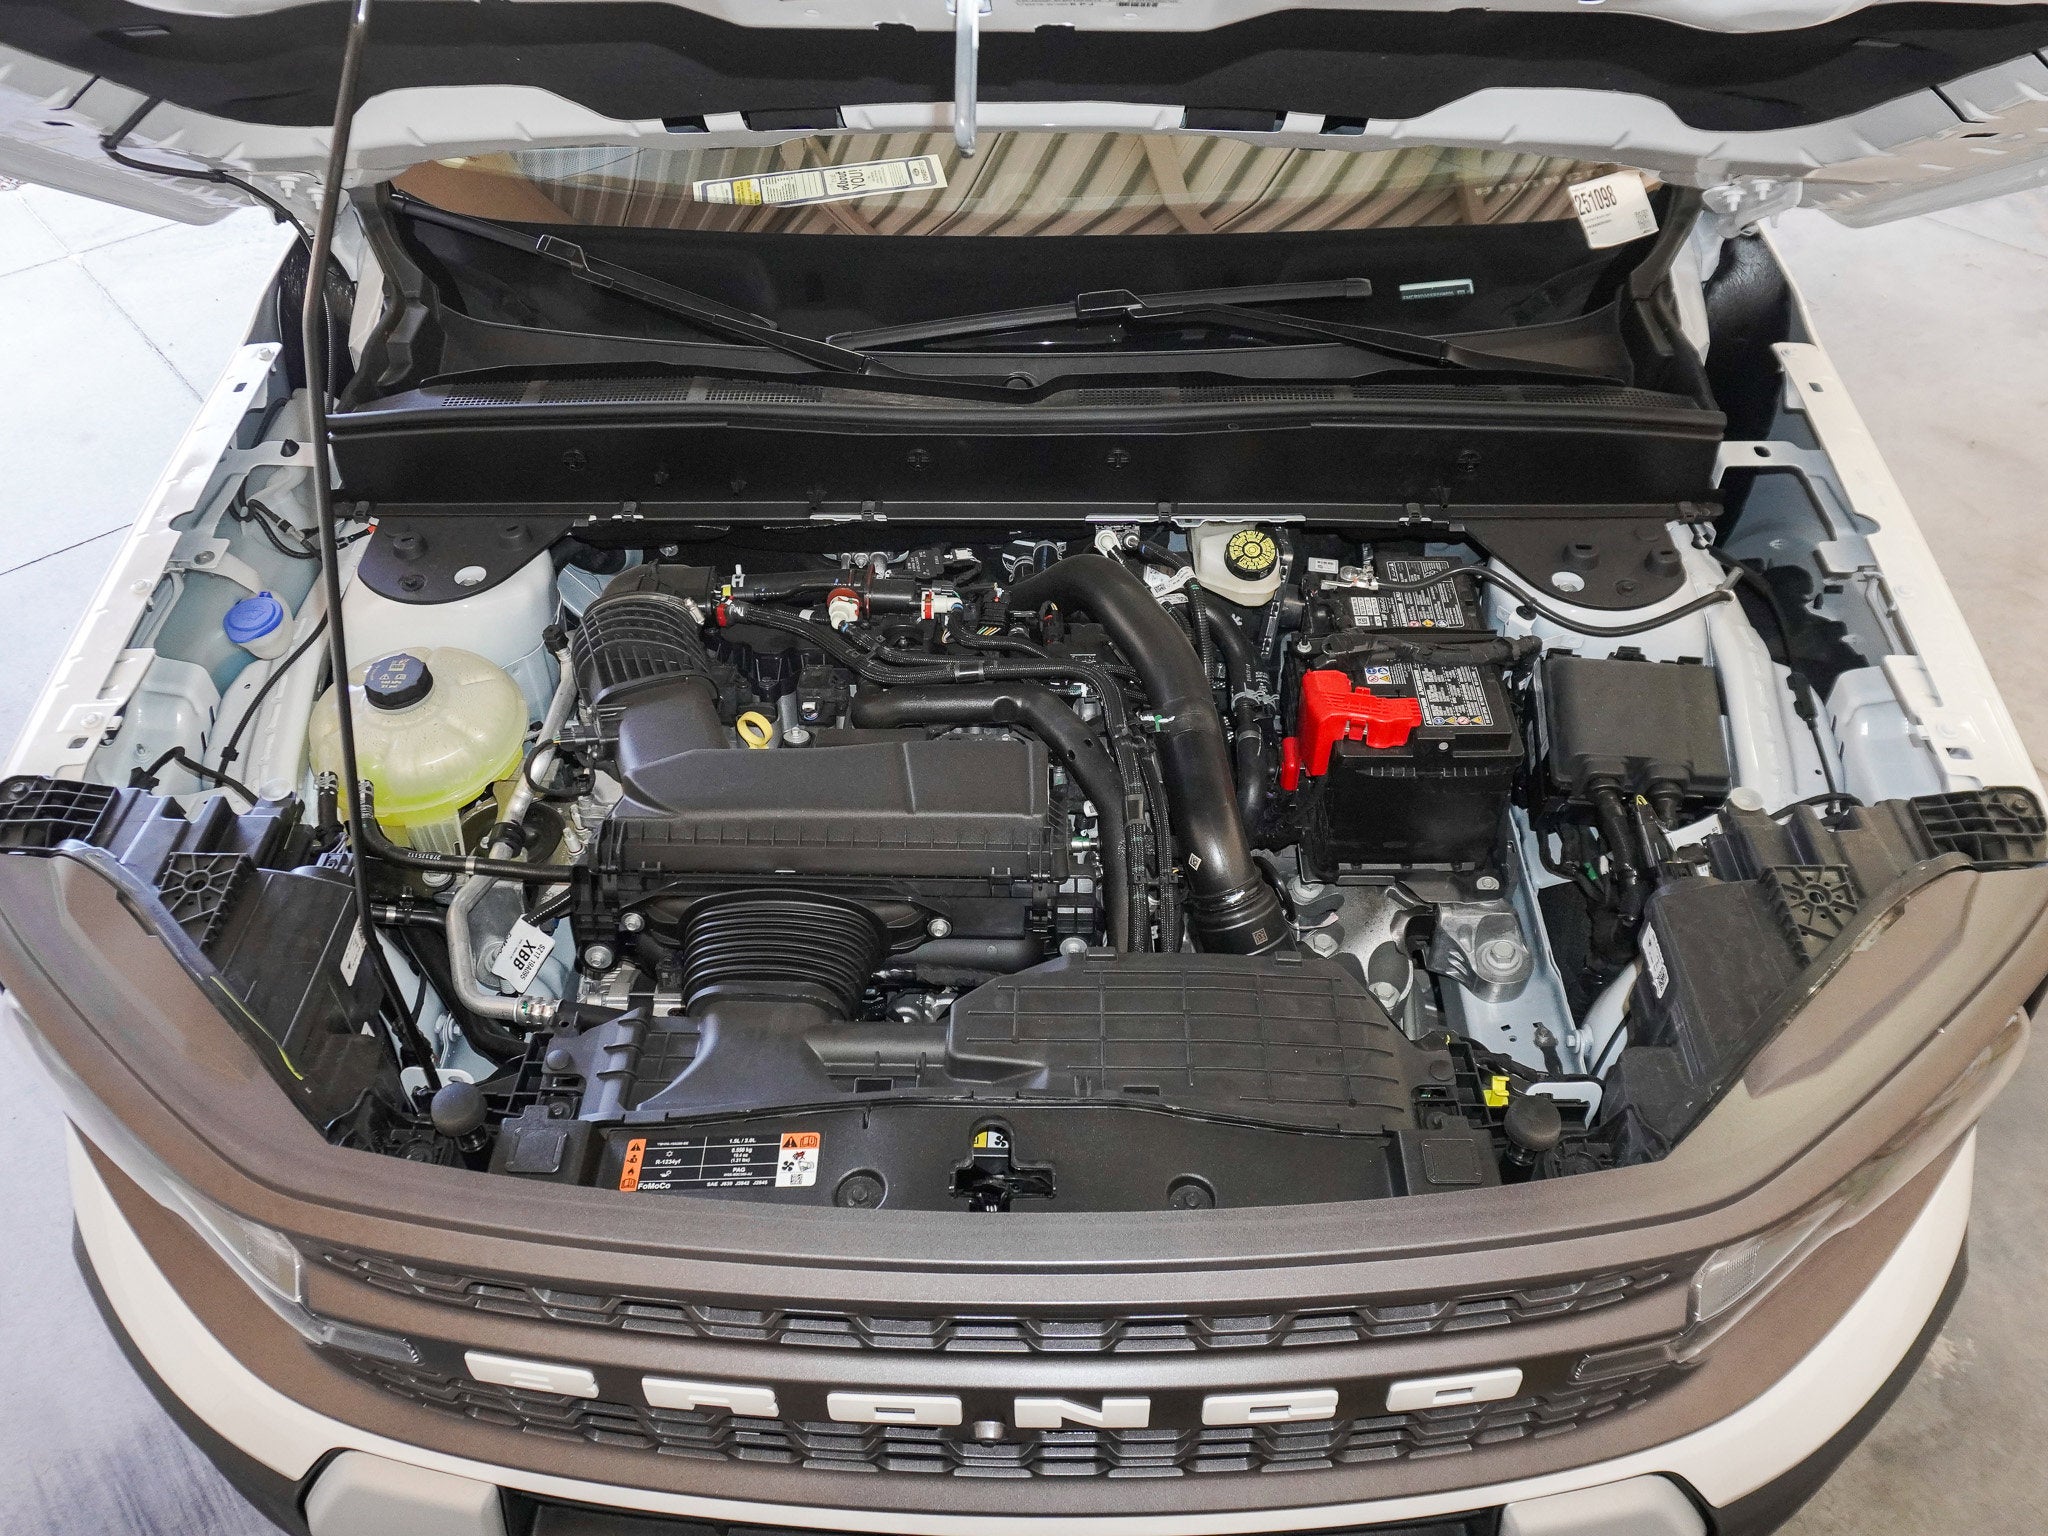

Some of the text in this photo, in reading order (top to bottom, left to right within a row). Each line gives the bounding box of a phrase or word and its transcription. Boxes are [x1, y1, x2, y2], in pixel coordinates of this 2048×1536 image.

[851, 168, 866, 190] YOU!
[1574, 185, 1617, 215] 251098
[513, 939, 537, 971] XBB
[655, 1158, 682, 1166] R-1234yf
[638, 1182, 671, 1190] FoMoCo
[463, 1350, 1524, 1429] BRONCO
